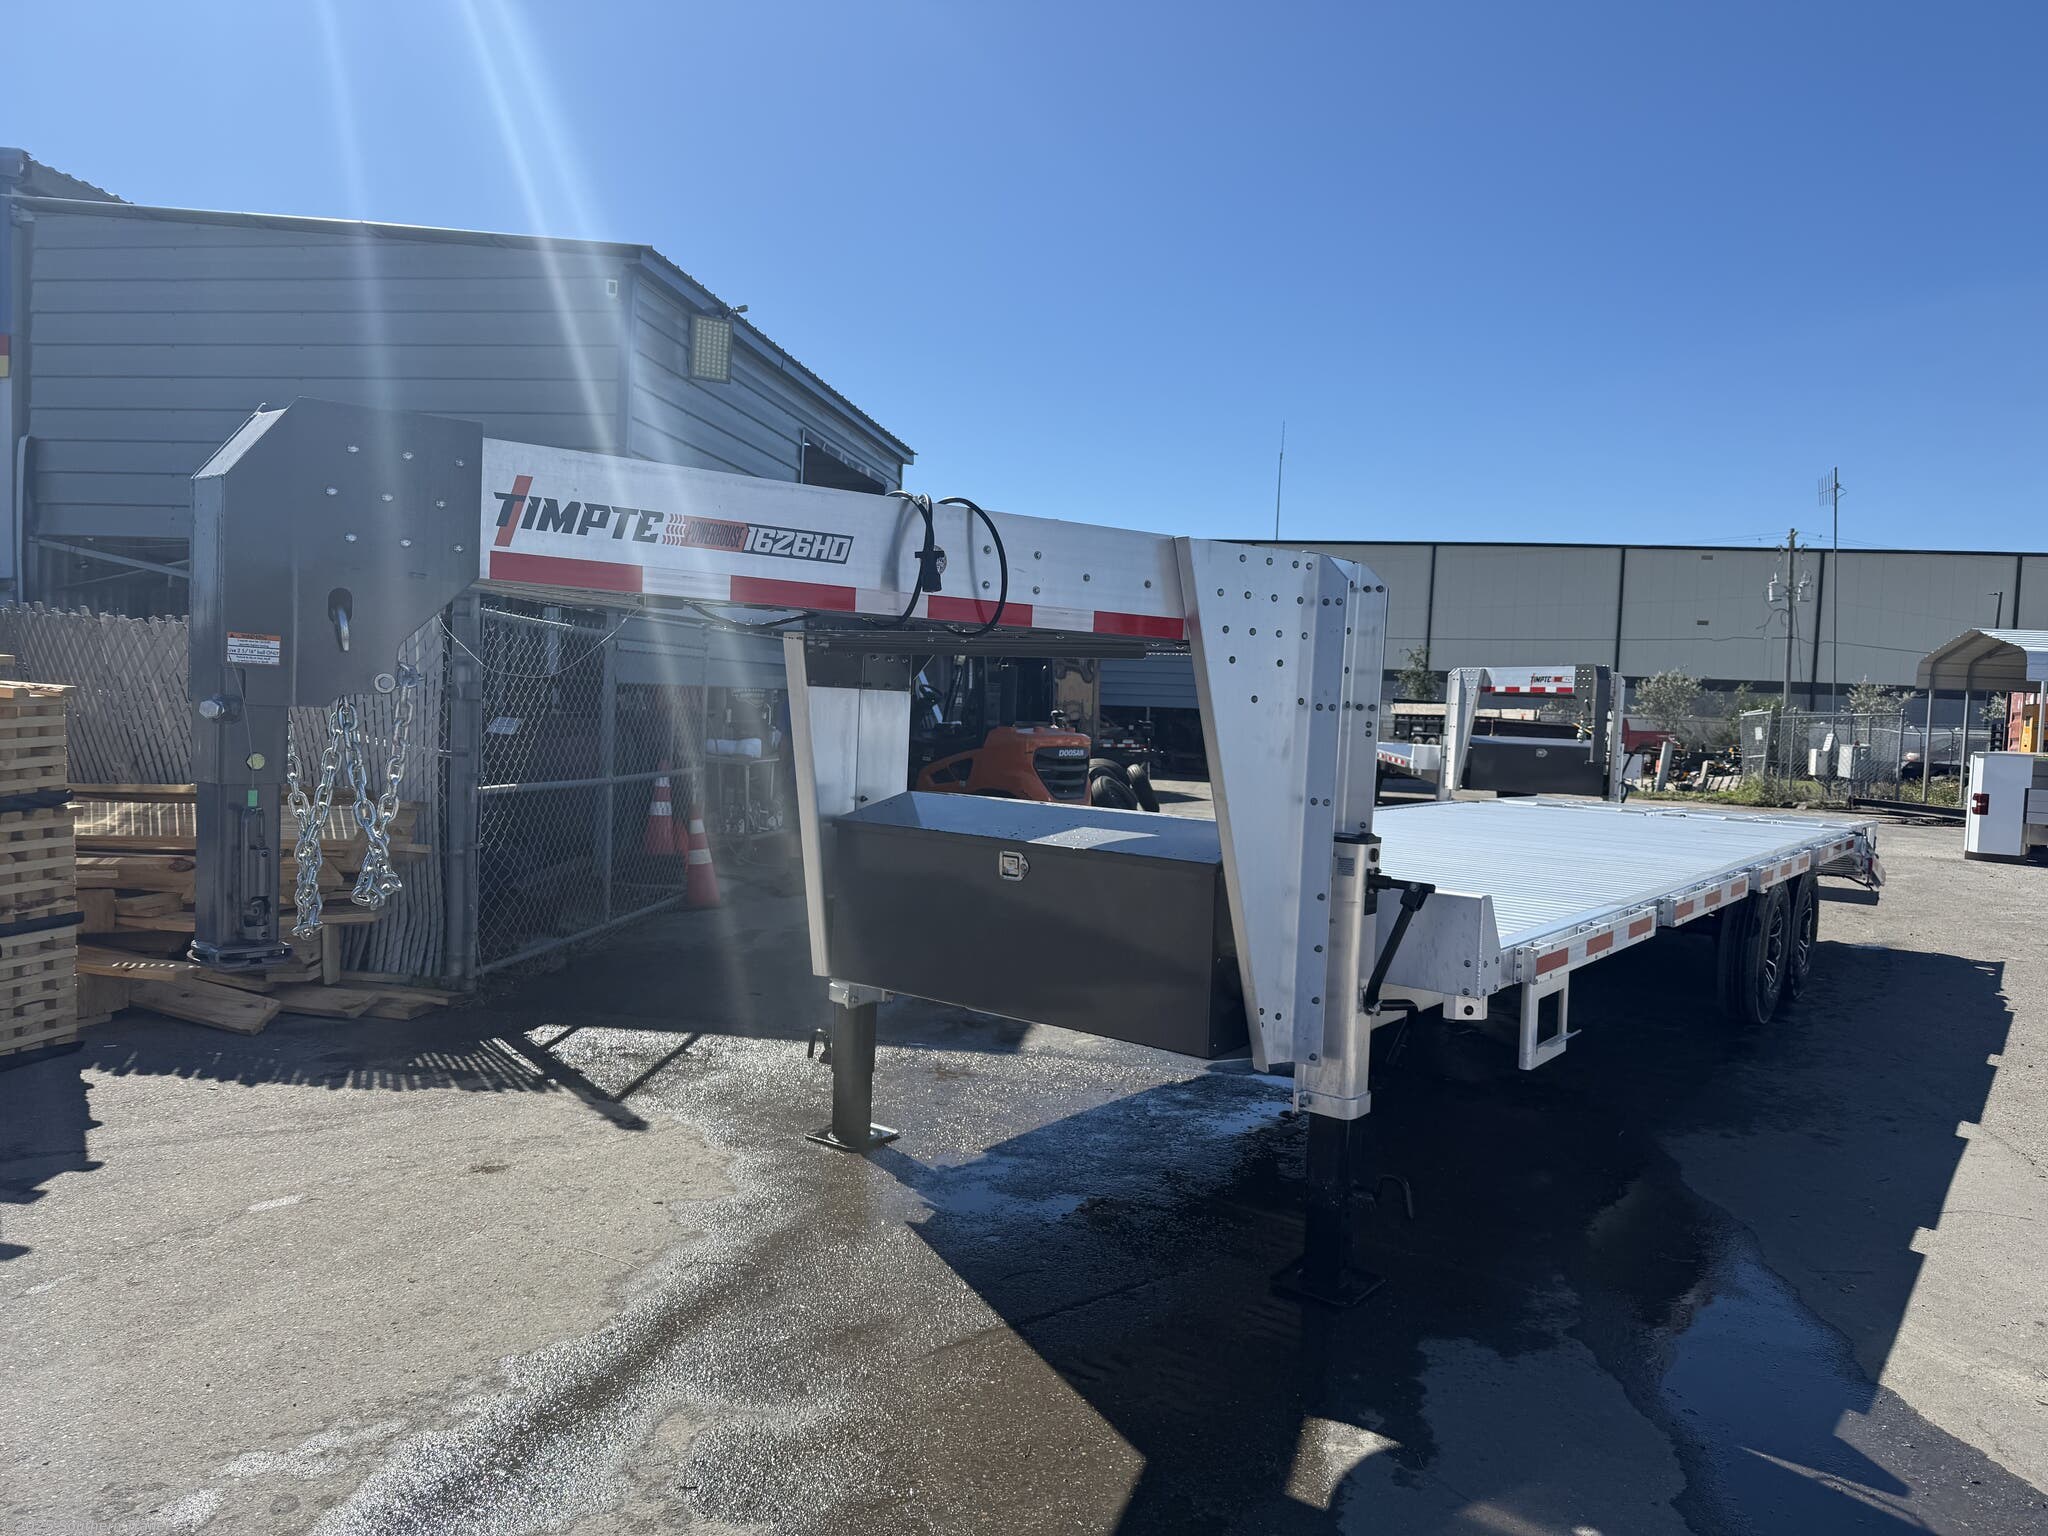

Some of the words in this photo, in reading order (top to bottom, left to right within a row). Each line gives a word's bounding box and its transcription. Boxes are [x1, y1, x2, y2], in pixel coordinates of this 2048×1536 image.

[493, 475, 664, 547] TIMPTE
[688, 520, 745, 549] POWERHOUSE
[743, 526, 851, 563] 1626HD
[1058, 749, 1085, 757] DOOSAN
